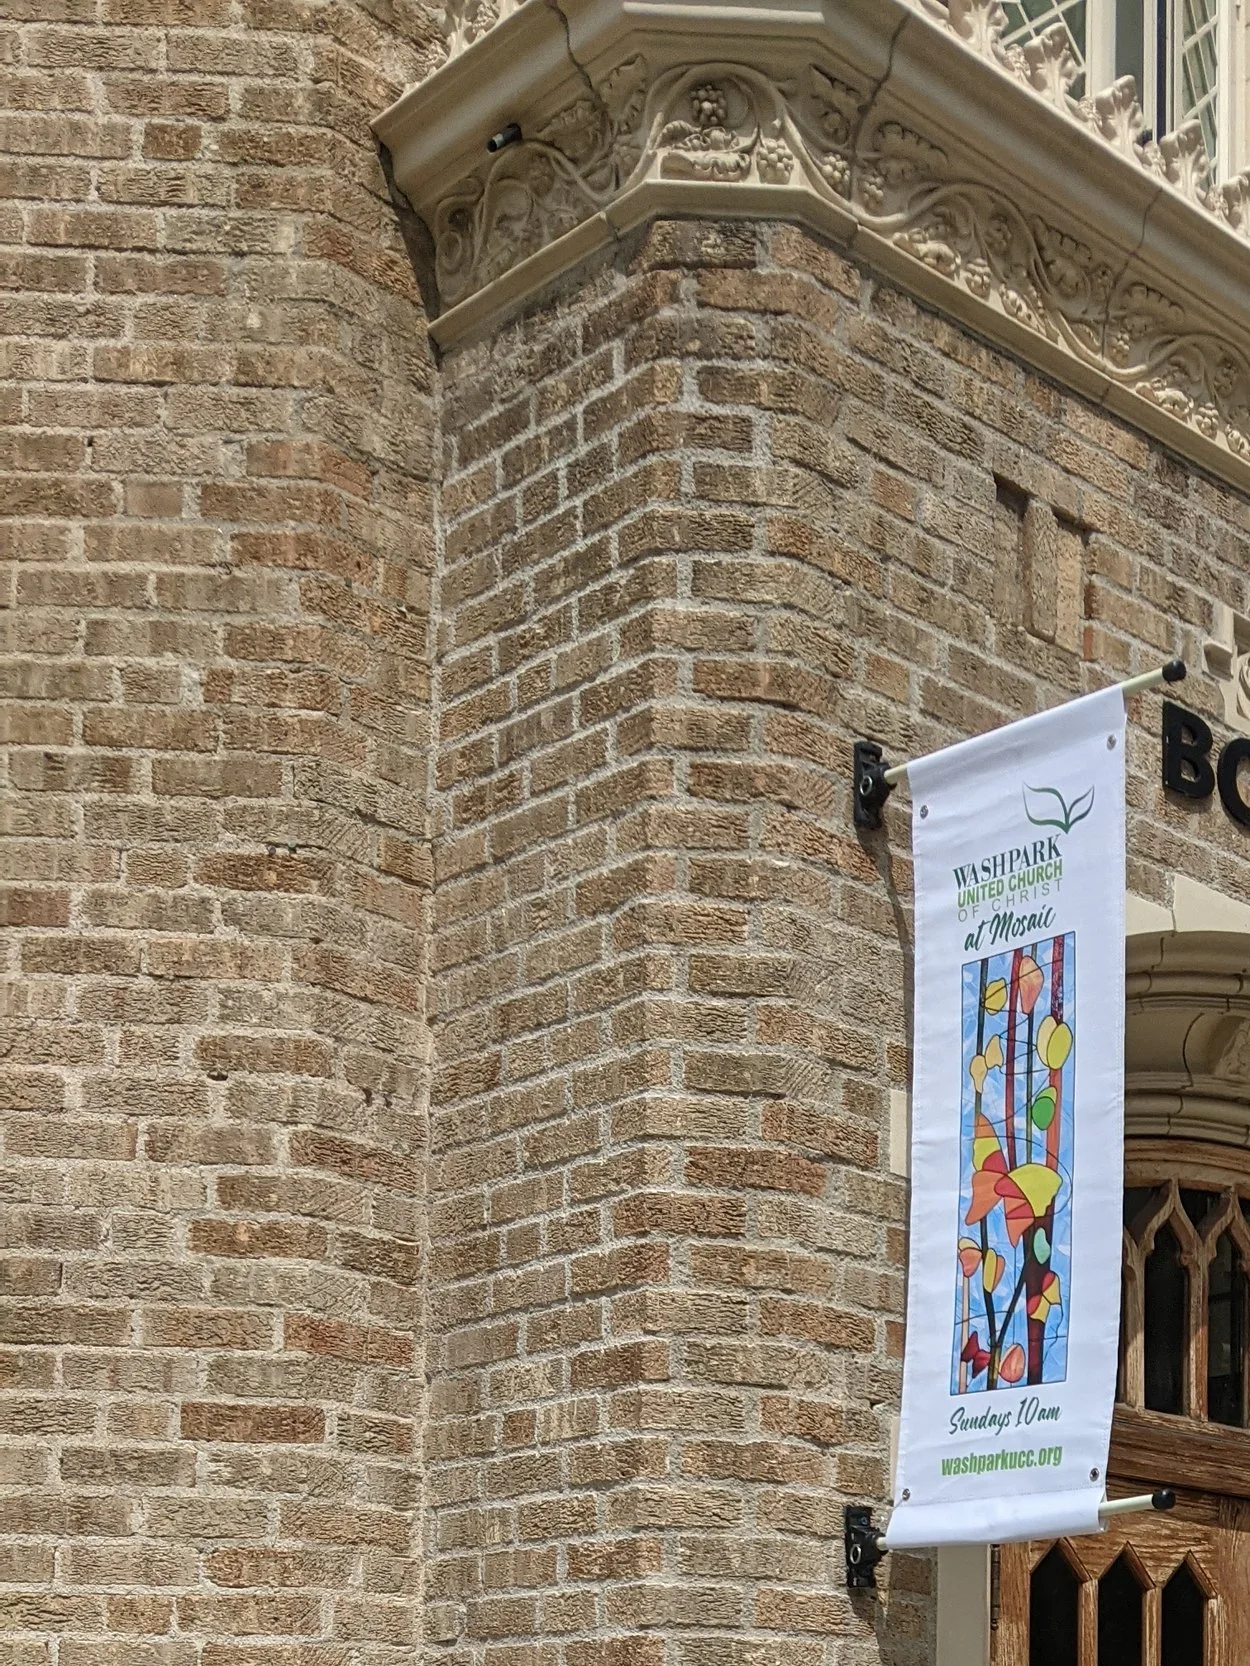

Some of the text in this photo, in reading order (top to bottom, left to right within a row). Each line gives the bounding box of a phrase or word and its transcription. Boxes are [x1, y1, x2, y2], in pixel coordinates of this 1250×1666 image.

[953, 833, 1062, 890] WASHPARK
[957, 858, 1063, 908] UNITED CHURCH
[958, 877, 1063, 922] OF CHRIST
[964, 904, 1056, 951] at Mosaic
[949, 1396, 1061, 1436] Sundays 10am
[941, 1446, 1063, 1476] washparkucc.org
